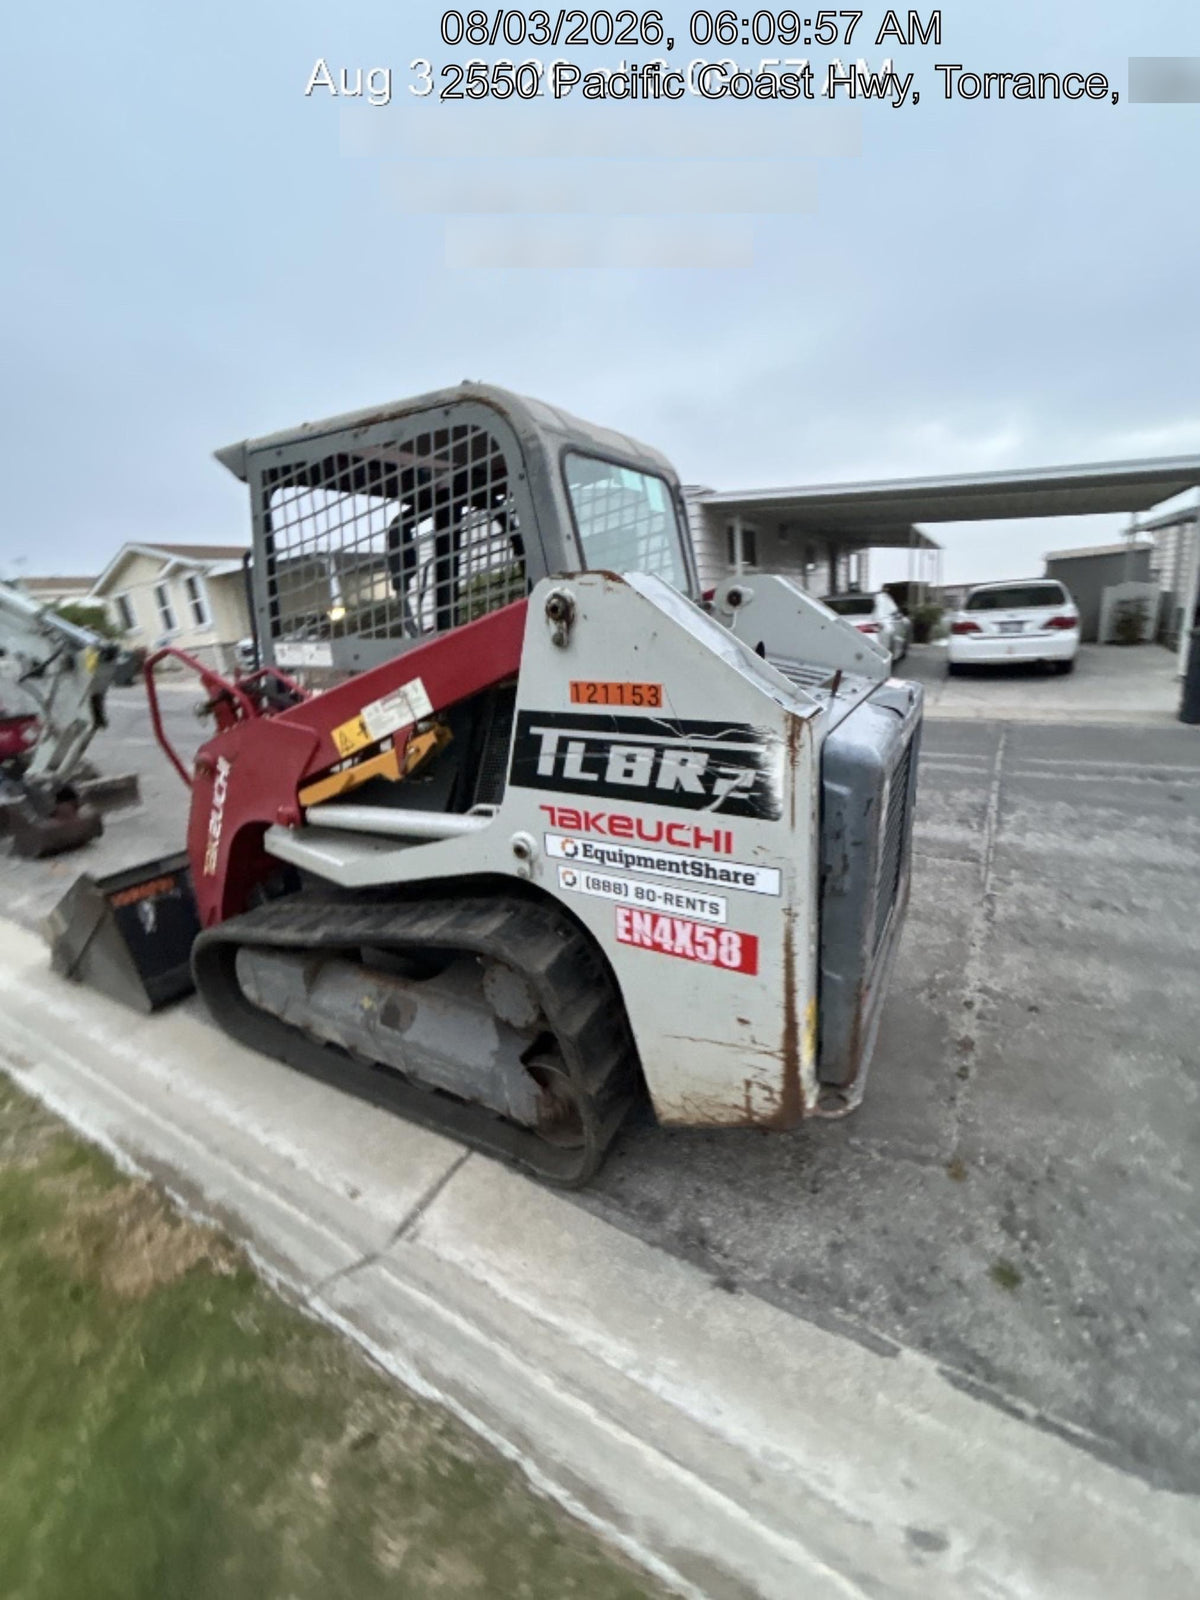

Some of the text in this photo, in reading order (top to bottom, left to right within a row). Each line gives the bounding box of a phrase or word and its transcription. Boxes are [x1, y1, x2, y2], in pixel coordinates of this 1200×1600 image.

[571, 682, 662, 706] 121153
[581, 843, 757, 886] EquipmentShare
[585, 875, 721, 915] (888) 80-RENTS
[615, 906, 743, 969] EN4X58
